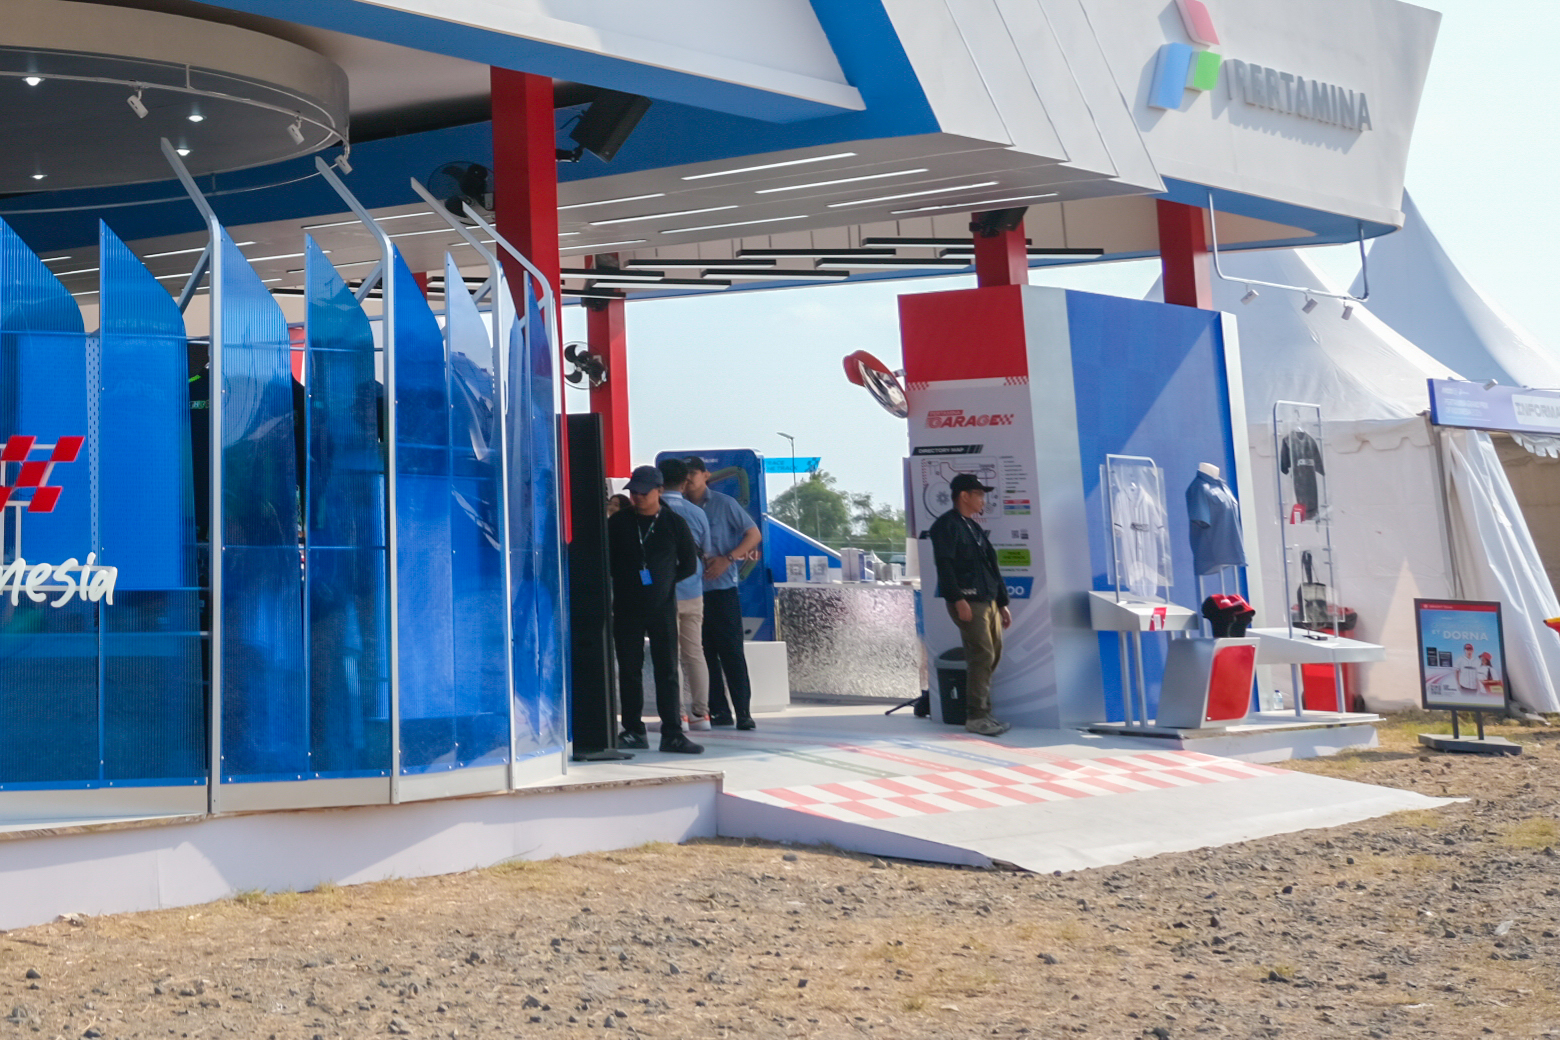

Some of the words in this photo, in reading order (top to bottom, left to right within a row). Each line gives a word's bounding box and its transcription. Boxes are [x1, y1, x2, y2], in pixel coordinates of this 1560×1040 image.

[1225, 58, 1373, 132] PERTAMINA
[926, 414, 1001, 429] GARAGE
[1443, 630, 1489, 641] DORNA
